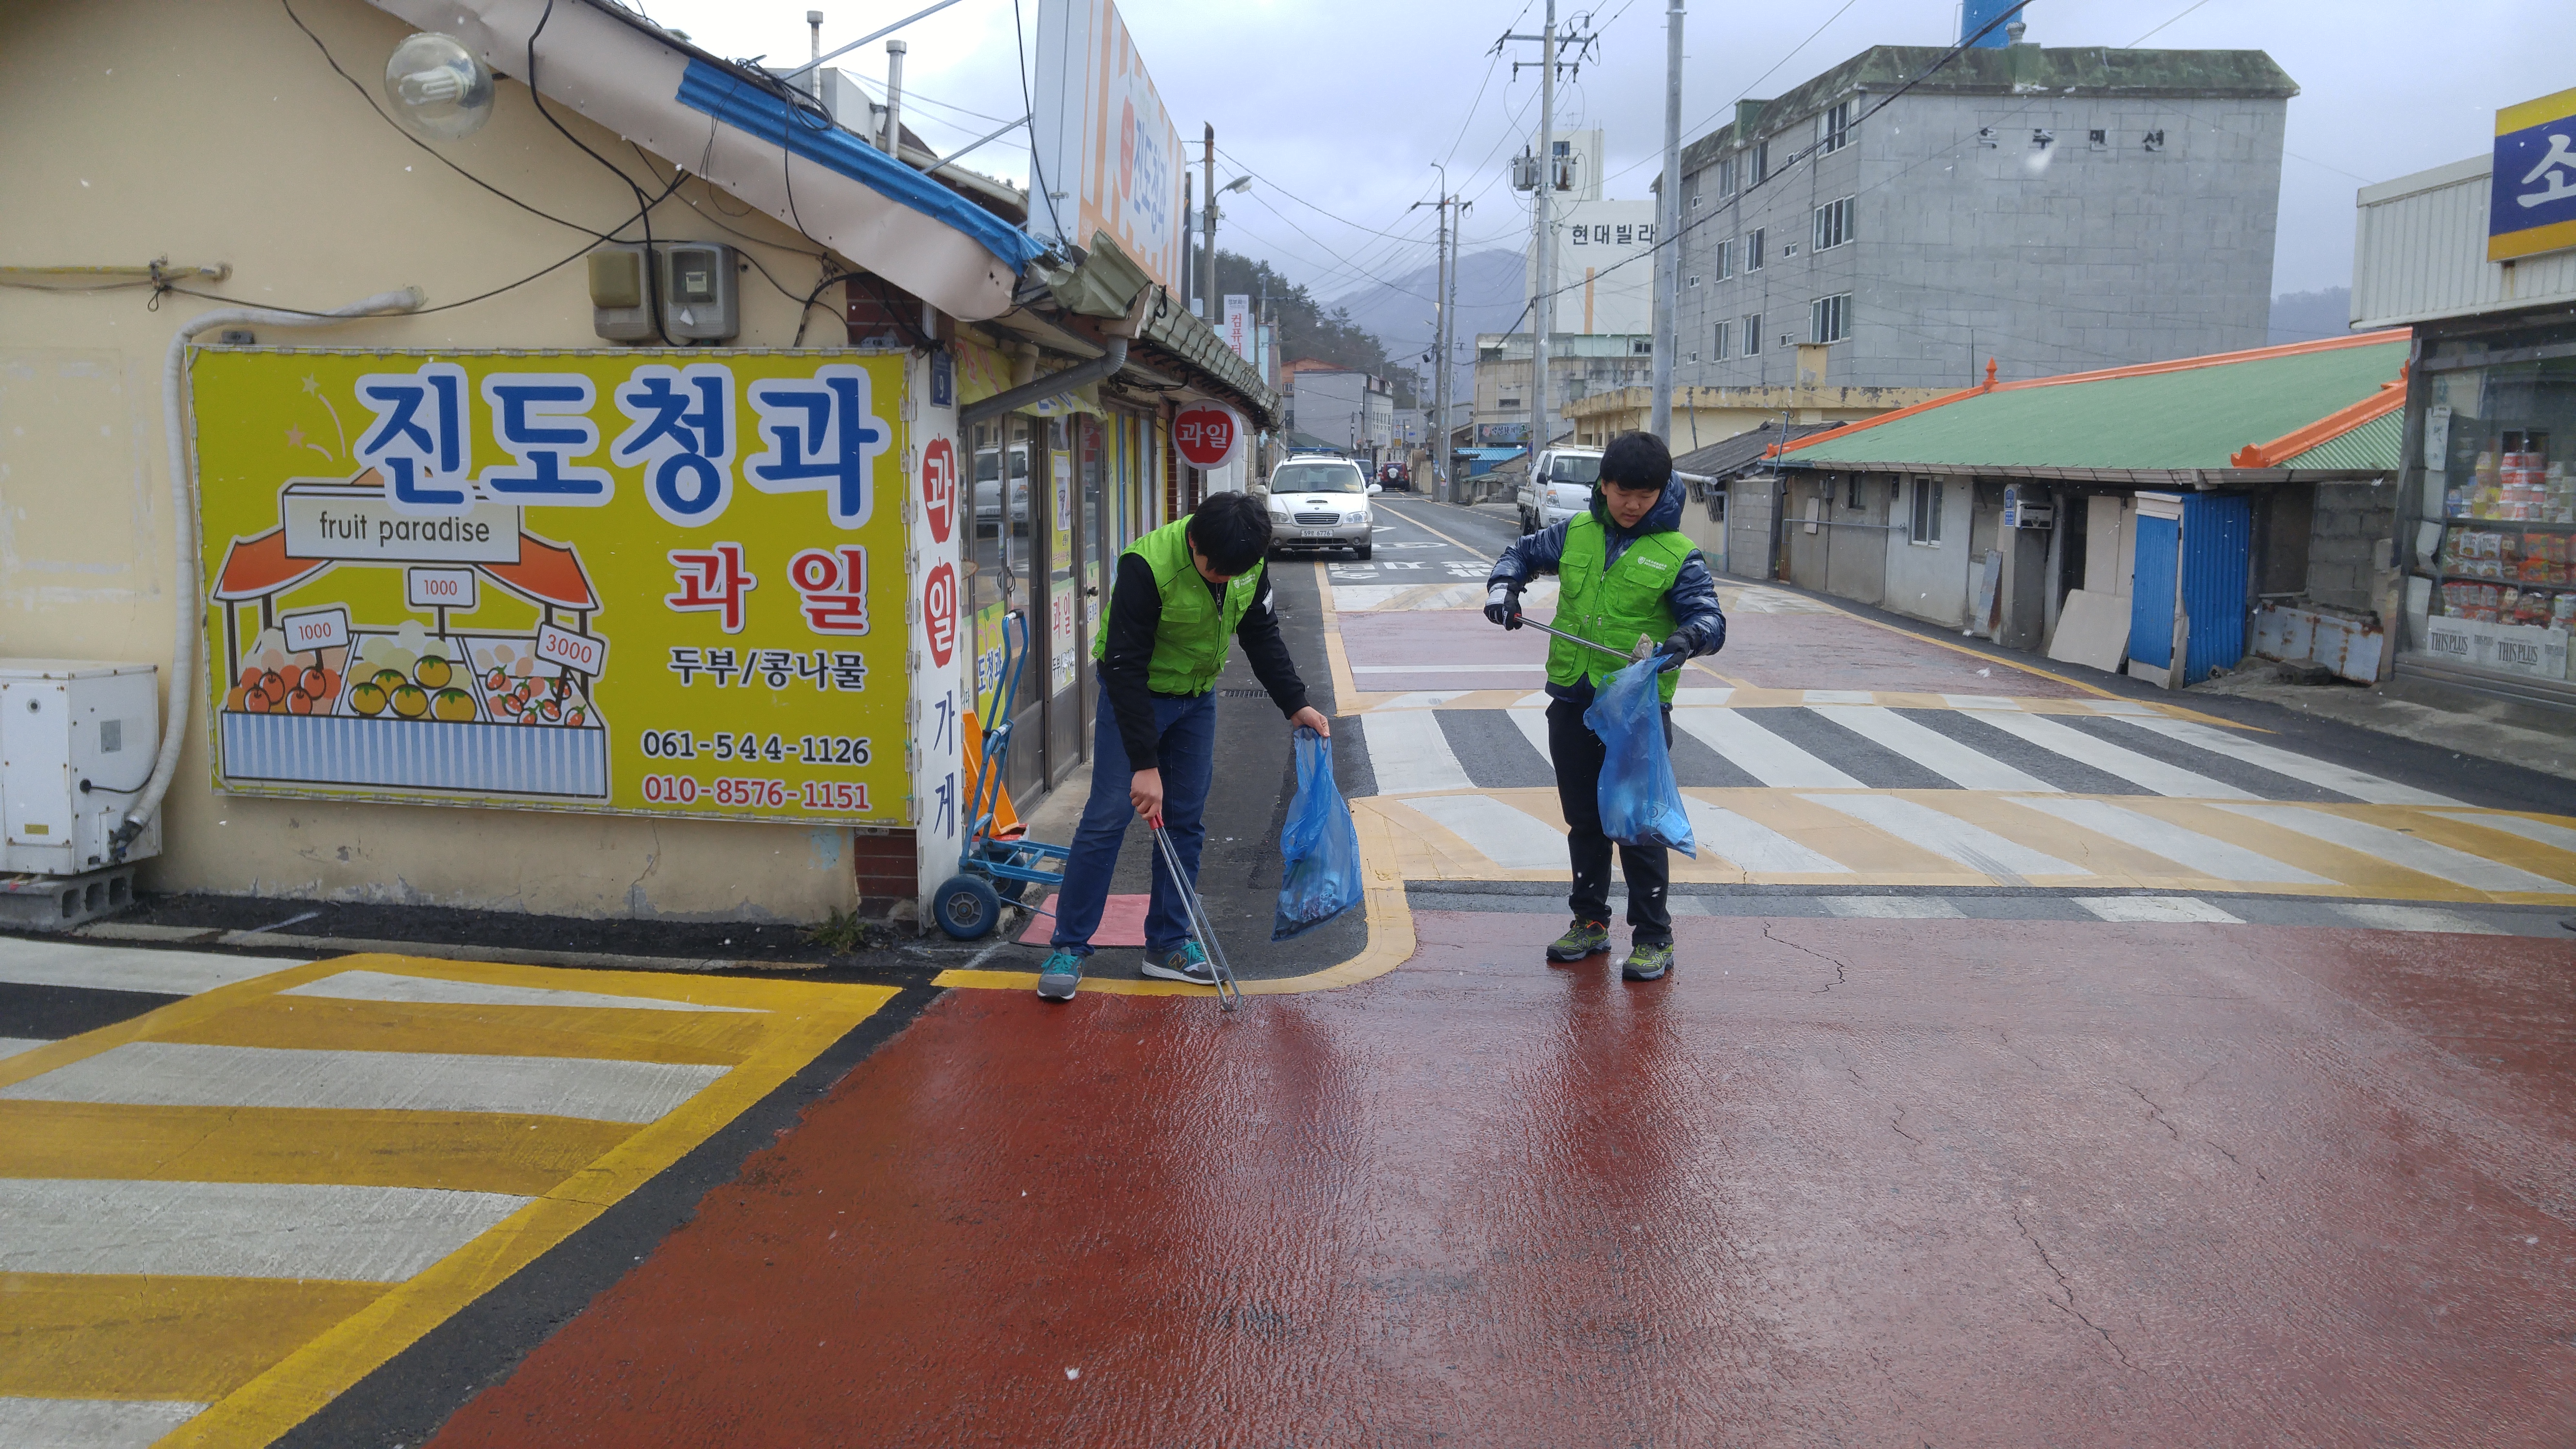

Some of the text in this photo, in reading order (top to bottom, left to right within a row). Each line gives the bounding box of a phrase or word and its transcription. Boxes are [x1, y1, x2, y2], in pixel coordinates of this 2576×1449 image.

[1572, 224, 1655, 245] 현대빌라
[1230, 313, 1242, 358] 컴퓨터
[939, 375, 944, 398] 9
[364, 375, 879, 516] 진도청과
[1178, 422, 1227, 449] 과일
[320, 512, 490, 547] fruit paradise
[424, 580, 458, 596] 1000
[298, 622, 332, 641] 1000
[2431, 632, 2468, 652] THIS PLUS
[546, 635, 592, 663] 3000
[2498, 641, 2538, 662] THIS PLUS
[670, 650, 866, 689] 두부/콩나물
[644, 731, 869, 763] 061-544-1126
[645, 776, 869, 809] 010-8576-1151
[1168, 952, 1187, 969] N
